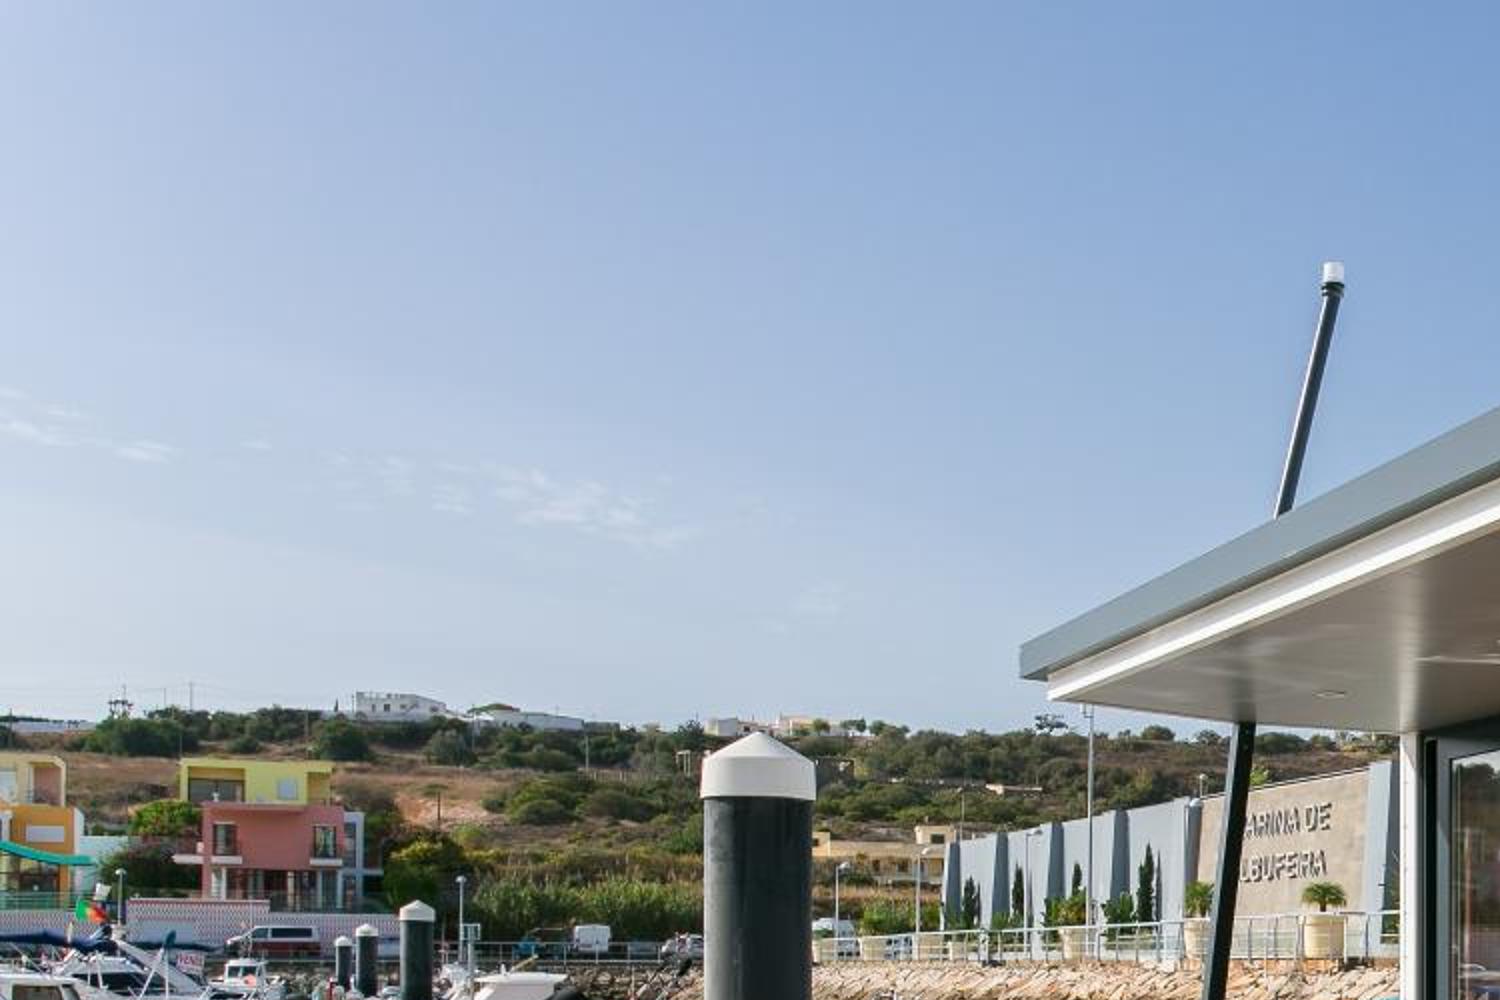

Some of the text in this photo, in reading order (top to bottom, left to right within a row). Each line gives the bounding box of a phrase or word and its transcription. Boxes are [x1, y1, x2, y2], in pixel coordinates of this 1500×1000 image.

[1244, 801, 1333, 841] ARINA DE
[1240, 849, 1328, 883] LBUFEIRA
